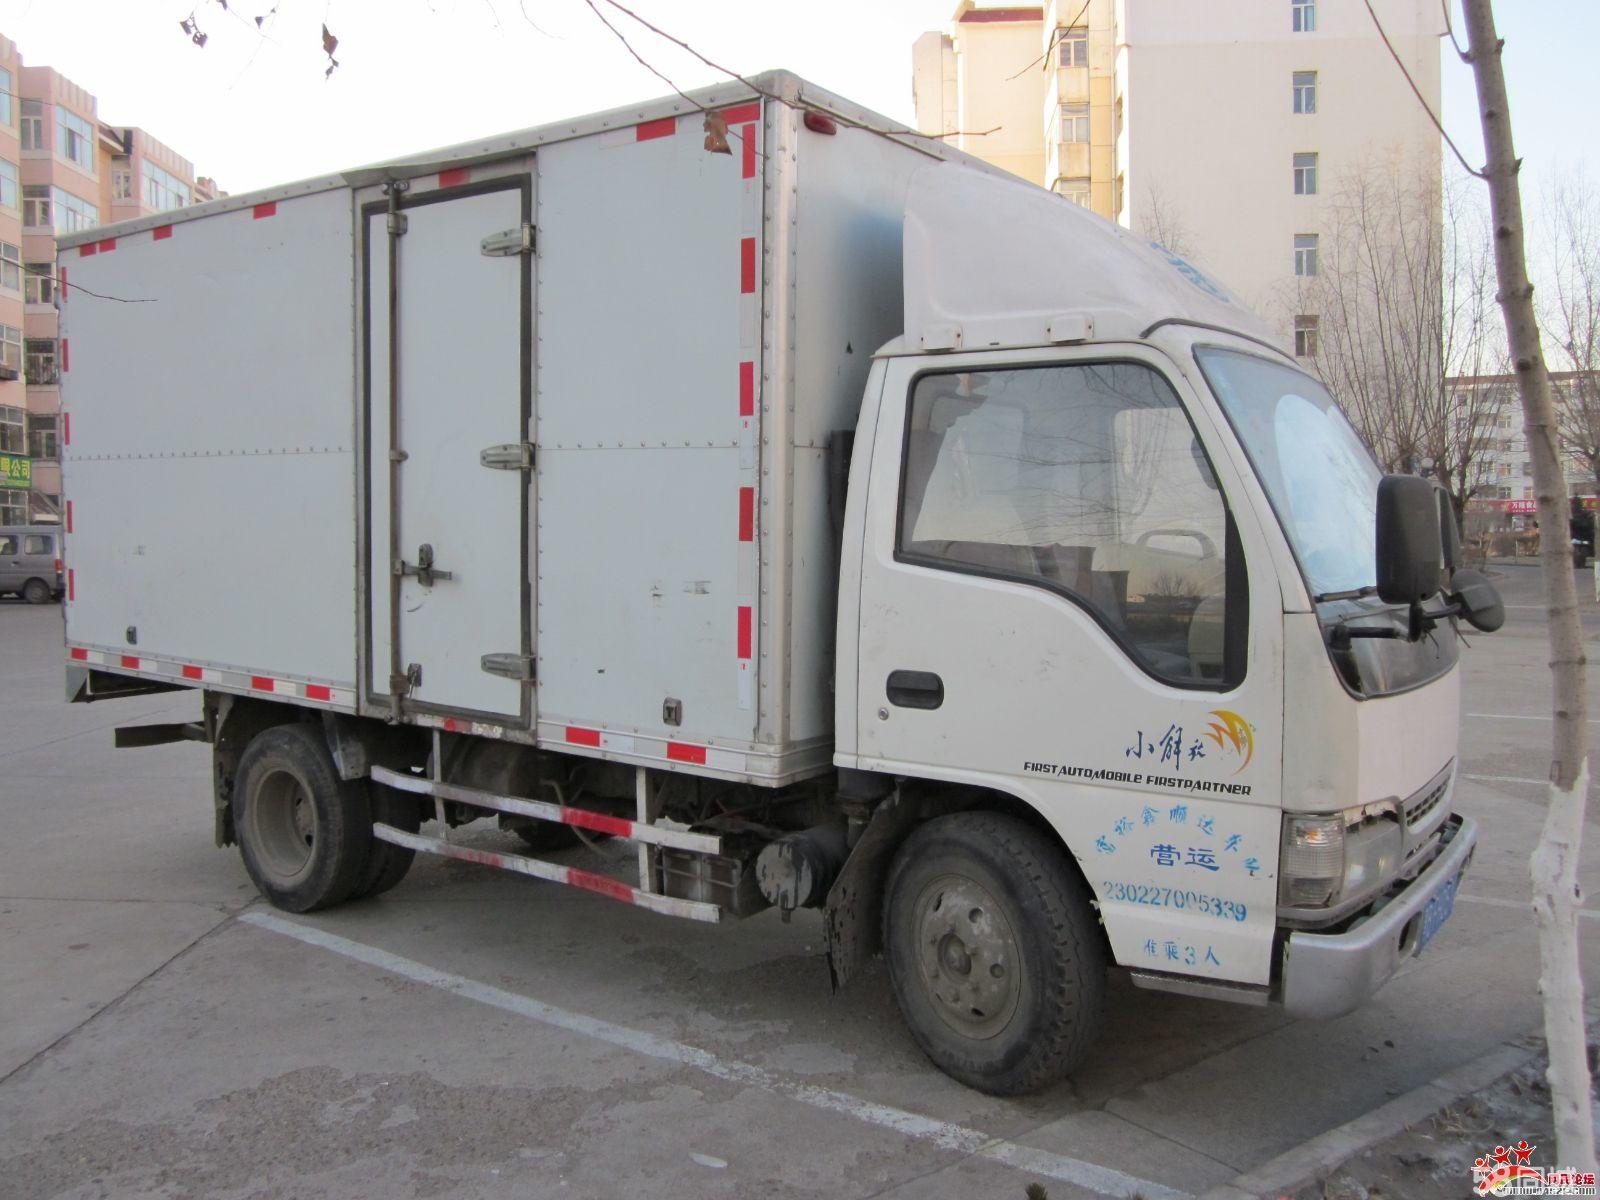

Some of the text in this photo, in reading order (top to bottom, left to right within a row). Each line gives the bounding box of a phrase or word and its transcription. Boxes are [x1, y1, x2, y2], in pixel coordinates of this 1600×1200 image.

[1023, 761, 1058, 774] FIRST
[1057, 765, 1142, 784] AUTOMOBILE
[1150, 843, 1220, 872] 营运
[1103, 880, 1248, 922] 230227005339
